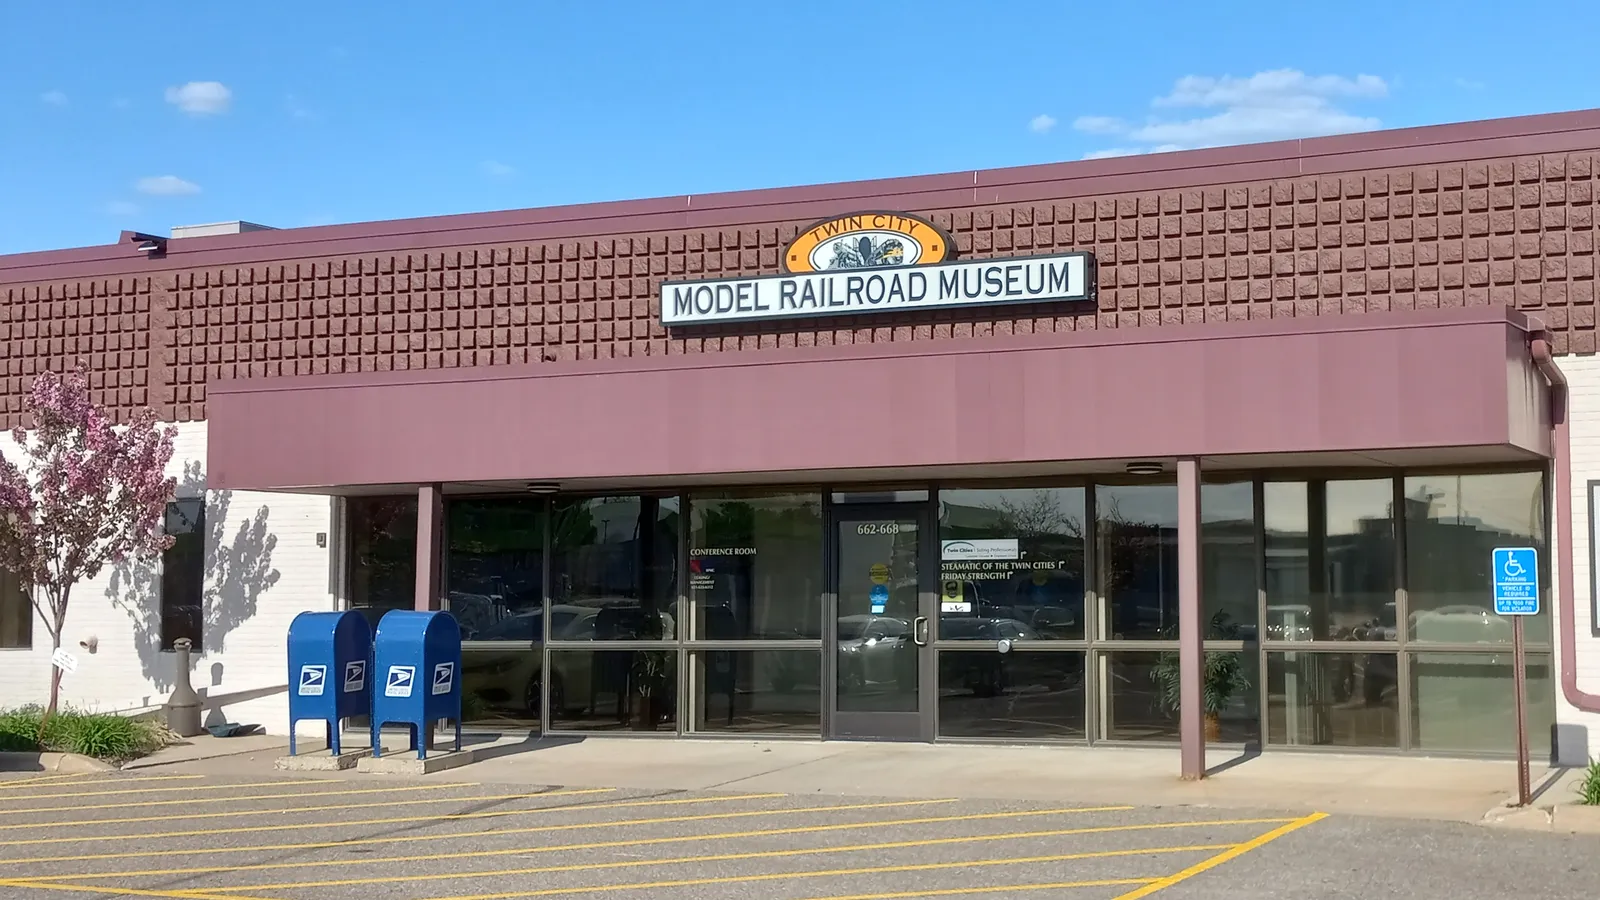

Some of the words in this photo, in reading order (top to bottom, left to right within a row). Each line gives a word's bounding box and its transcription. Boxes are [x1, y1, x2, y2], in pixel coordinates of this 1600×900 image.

[809, 215, 862, 242] TWIN
[872, 214, 920, 235] CITY
[672, 282, 770, 317] MODEL
[778, 272, 928, 310] RAILROAD
[938, 262, 1071, 300] MUSEUM
[857, 523, 899, 535] 662-668
[690, 547, 733, 556] CONFERENCE
[734, 547, 757, 556] ROOM
[941, 561, 981, 571] STEAMATIC
[982, 561, 994, 570] OF
[994, 561, 1010, 570] THE
[1010, 561, 1031, 570] TWIN
[1032, 560, 1056, 569] CITIES
[940, 572, 966, 580] FRIDAY
[966, 571, 1006, 580] STRENGTH
